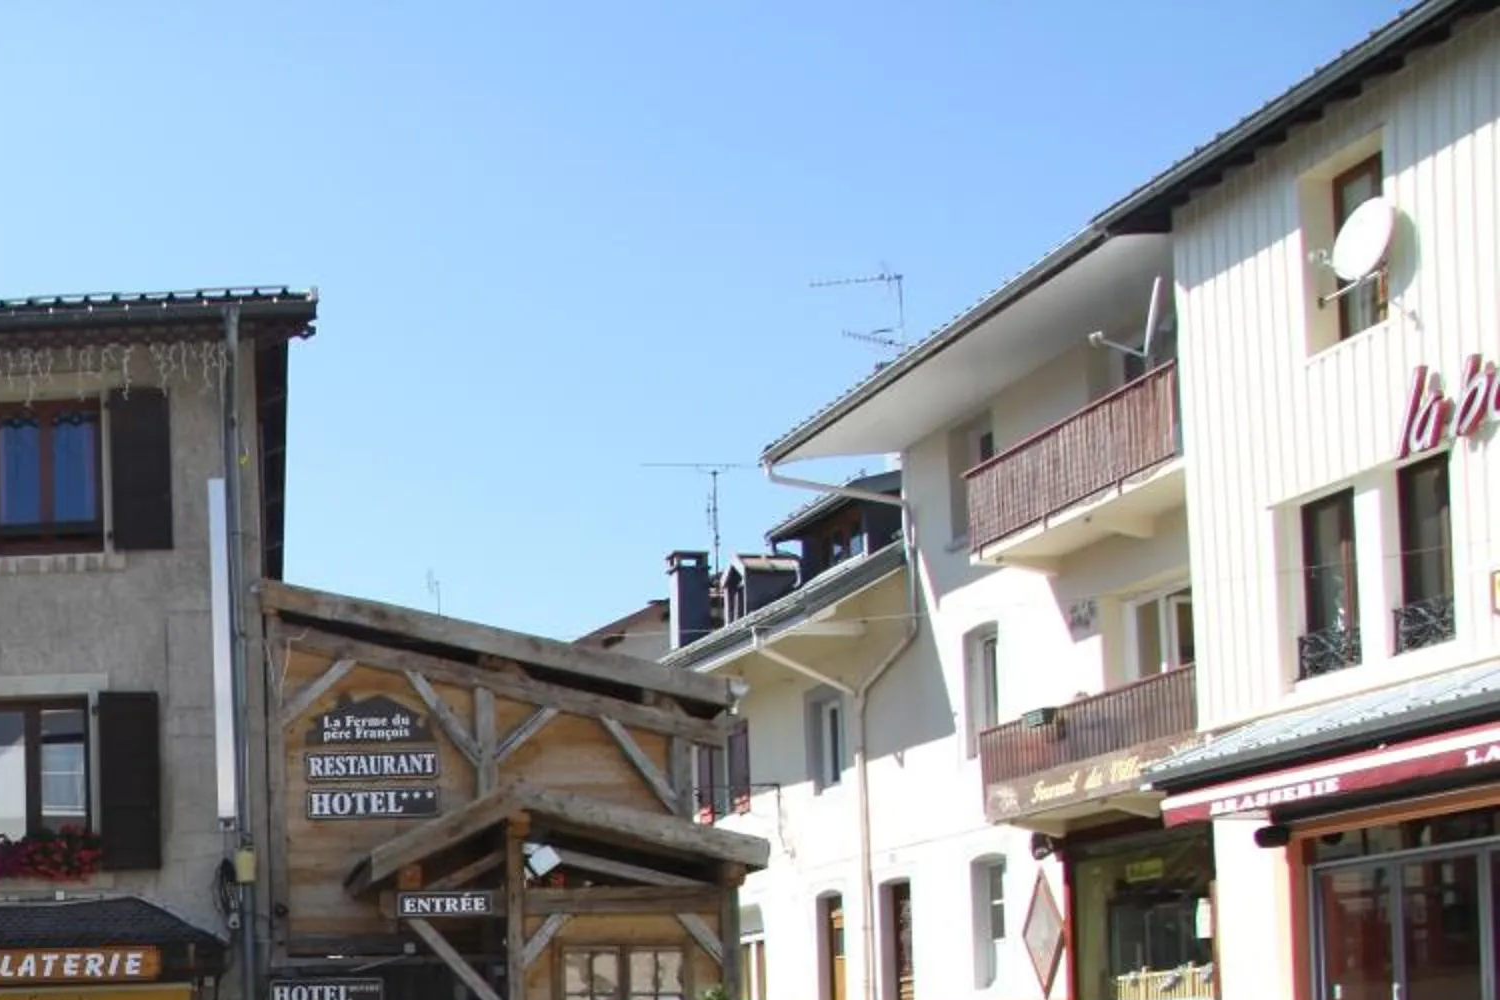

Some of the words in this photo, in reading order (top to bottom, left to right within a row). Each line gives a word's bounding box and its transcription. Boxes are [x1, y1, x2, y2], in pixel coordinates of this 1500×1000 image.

[323, 715, 341, 728] La
[346, 714, 388, 728] Ferme
[392, 713, 410, 727] du
[323, 729, 351, 742] père
[355, 726, 410, 741] François
[308, 753, 436, 777] RESTAURANT
[311, 790, 404, 816] HOTEL
[1209, 777, 1341, 816] BRASSERIE
[403, 892, 486, 914] ENTRÉE
